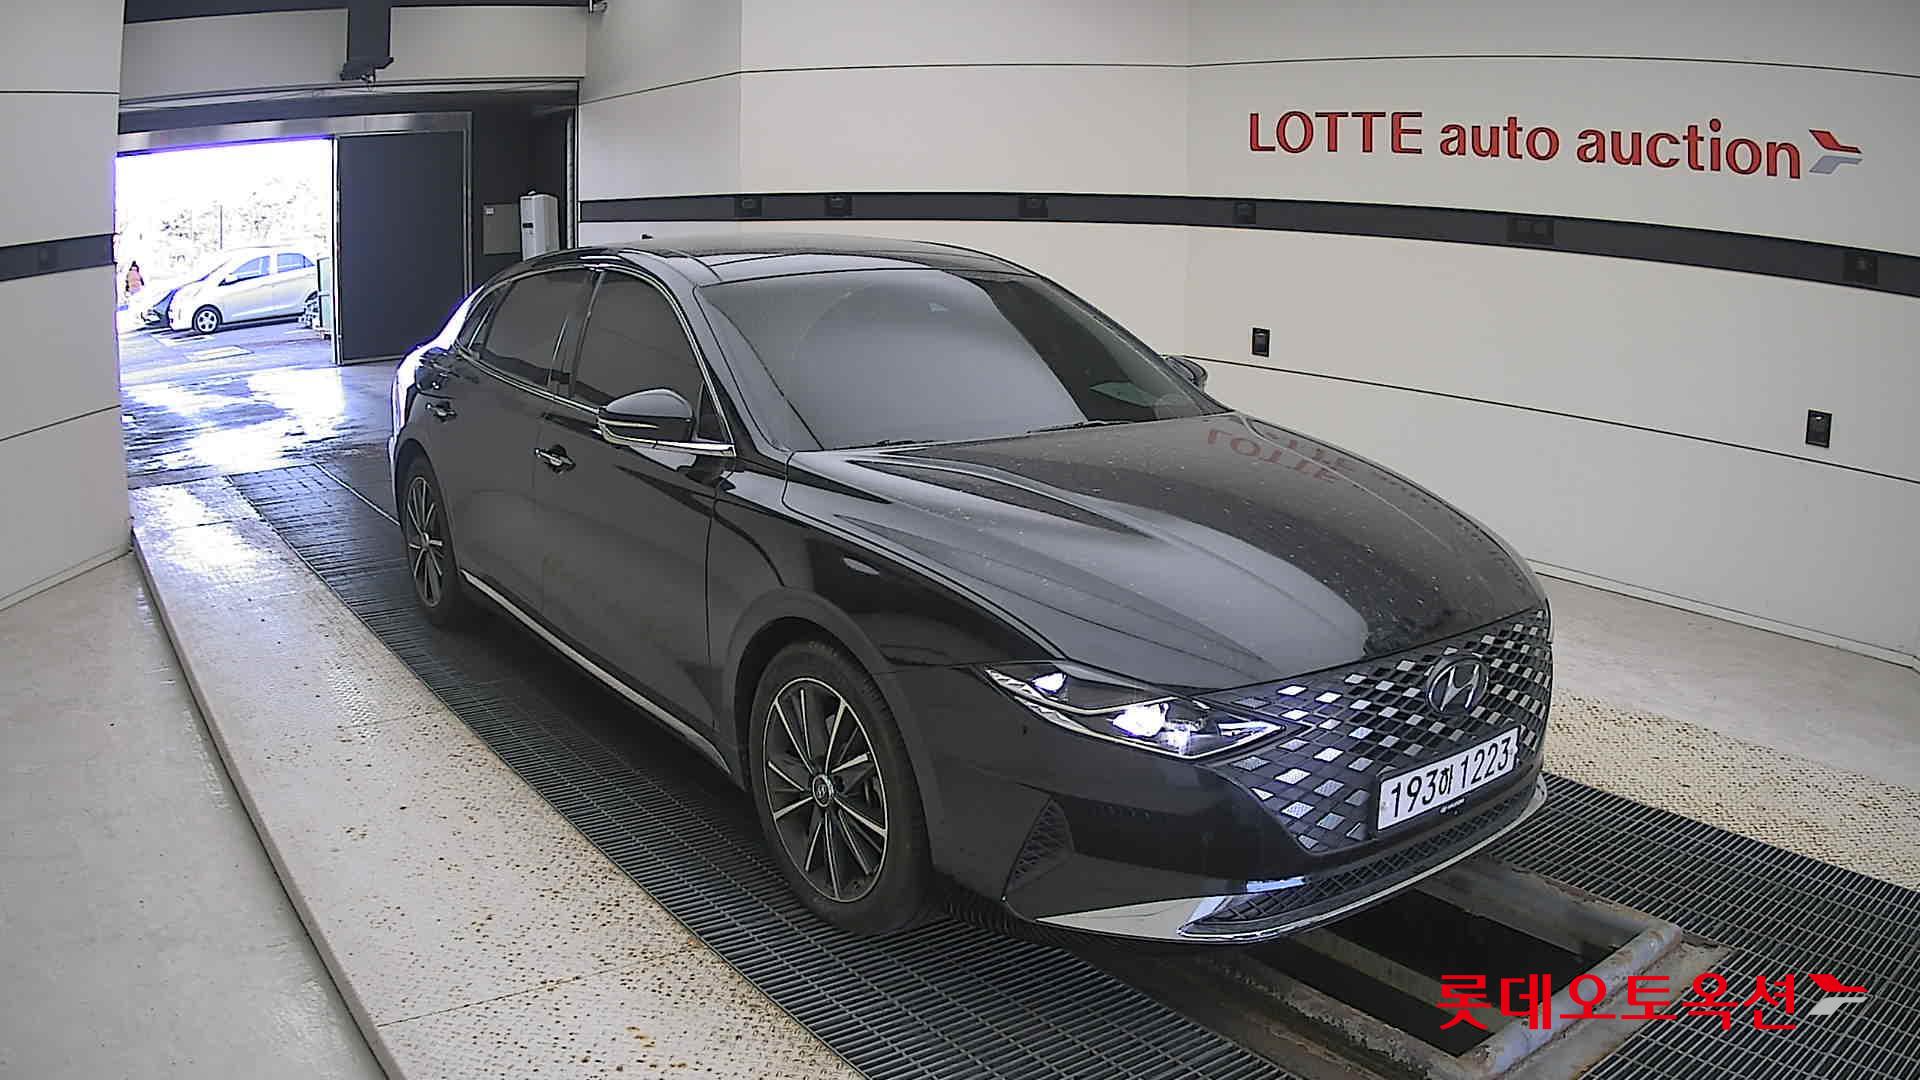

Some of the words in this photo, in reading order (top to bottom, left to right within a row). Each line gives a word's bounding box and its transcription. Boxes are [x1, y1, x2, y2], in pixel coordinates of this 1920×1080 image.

[1249, 111, 1423, 154] LOTTE
[1439, 116, 1560, 160] auto
[1577, 119, 1801, 179] auction
[1391, 764, 1454, 818] 193하
[1460, 736, 1511, 789] 1223
